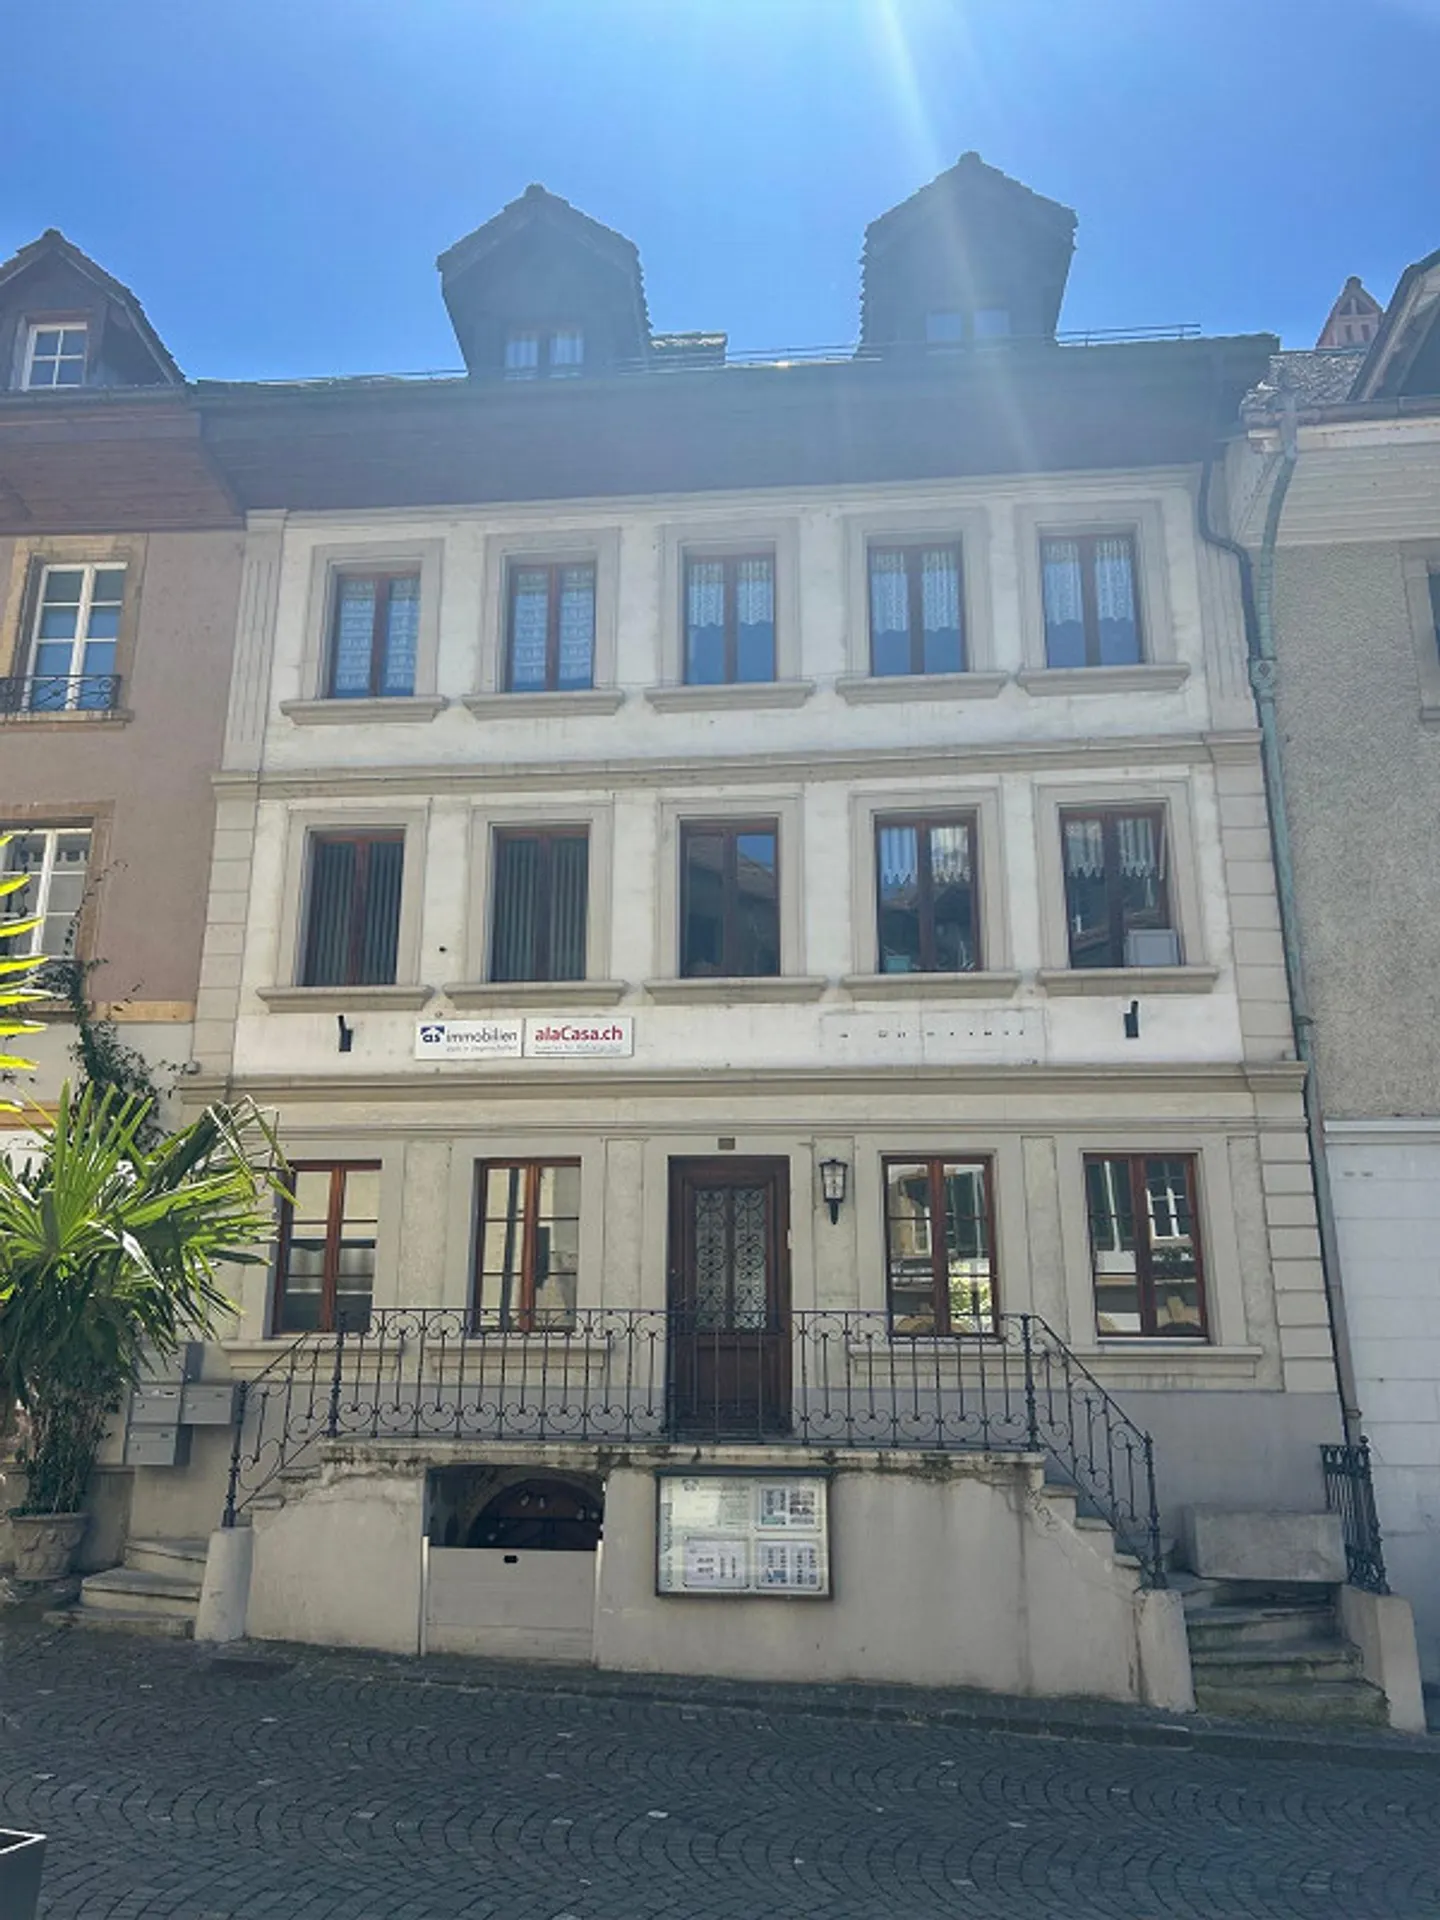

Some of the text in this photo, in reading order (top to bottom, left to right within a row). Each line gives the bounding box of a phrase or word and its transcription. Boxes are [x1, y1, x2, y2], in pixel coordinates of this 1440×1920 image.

[422, 1027, 518, 1043] as immobilien
[535, 1025, 623, 1042] alaCasa.ch
